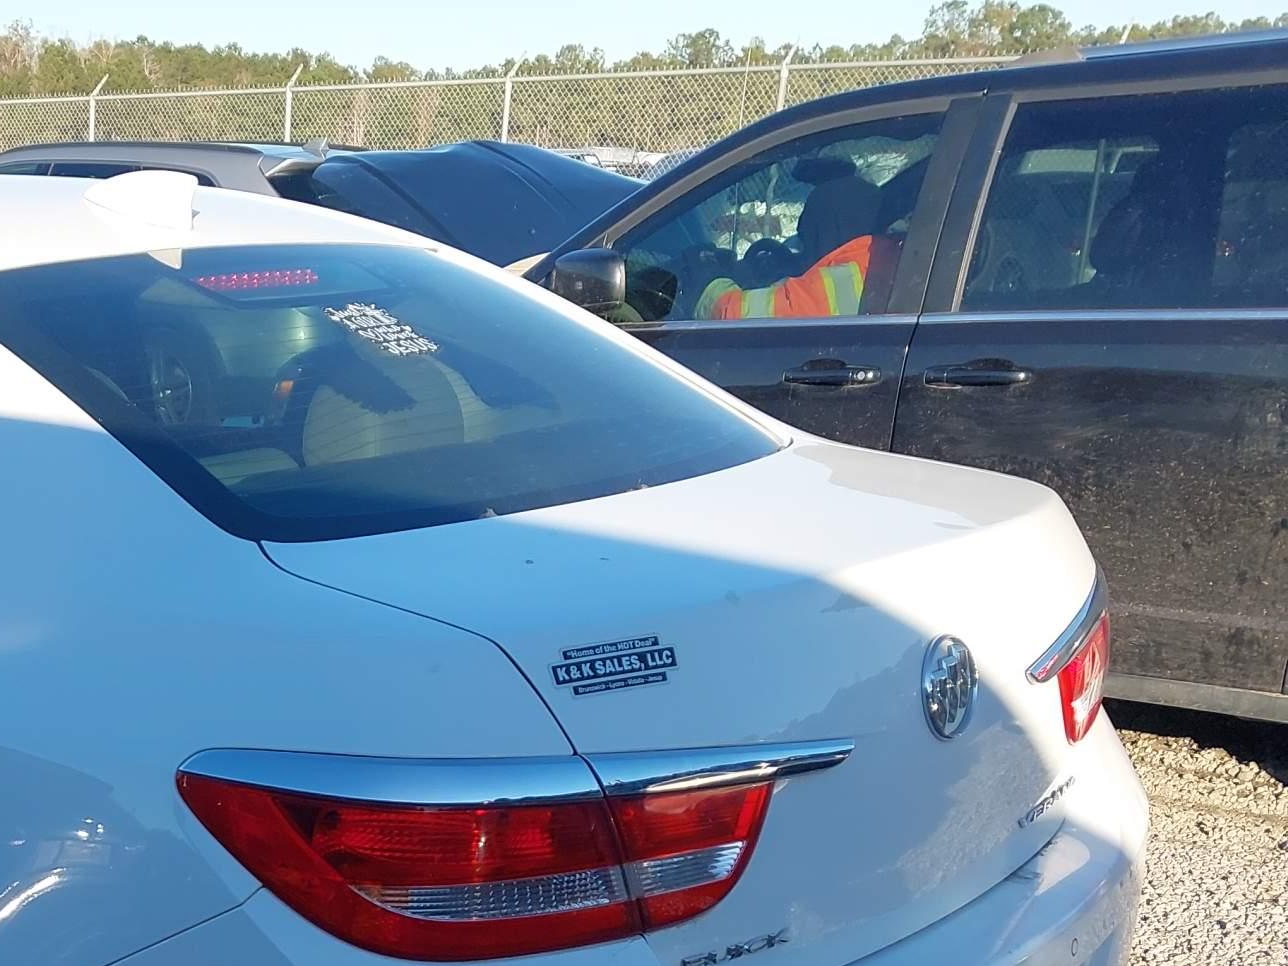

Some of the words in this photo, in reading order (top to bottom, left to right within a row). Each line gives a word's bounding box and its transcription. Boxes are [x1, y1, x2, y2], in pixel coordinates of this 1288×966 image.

[382, 337, 438, 356] JESUS
[595, 647, 603, 655] of
[603, 644, 618, 653] the
[617, 639, 635, 650] HOT
[557, 666, 571, 681] K
[570, 665, 582, 679] &
[581, 662, 594, 677] K
[594, 655, 645, 671] SALES,
[646, 649, 673, 667] LLC
